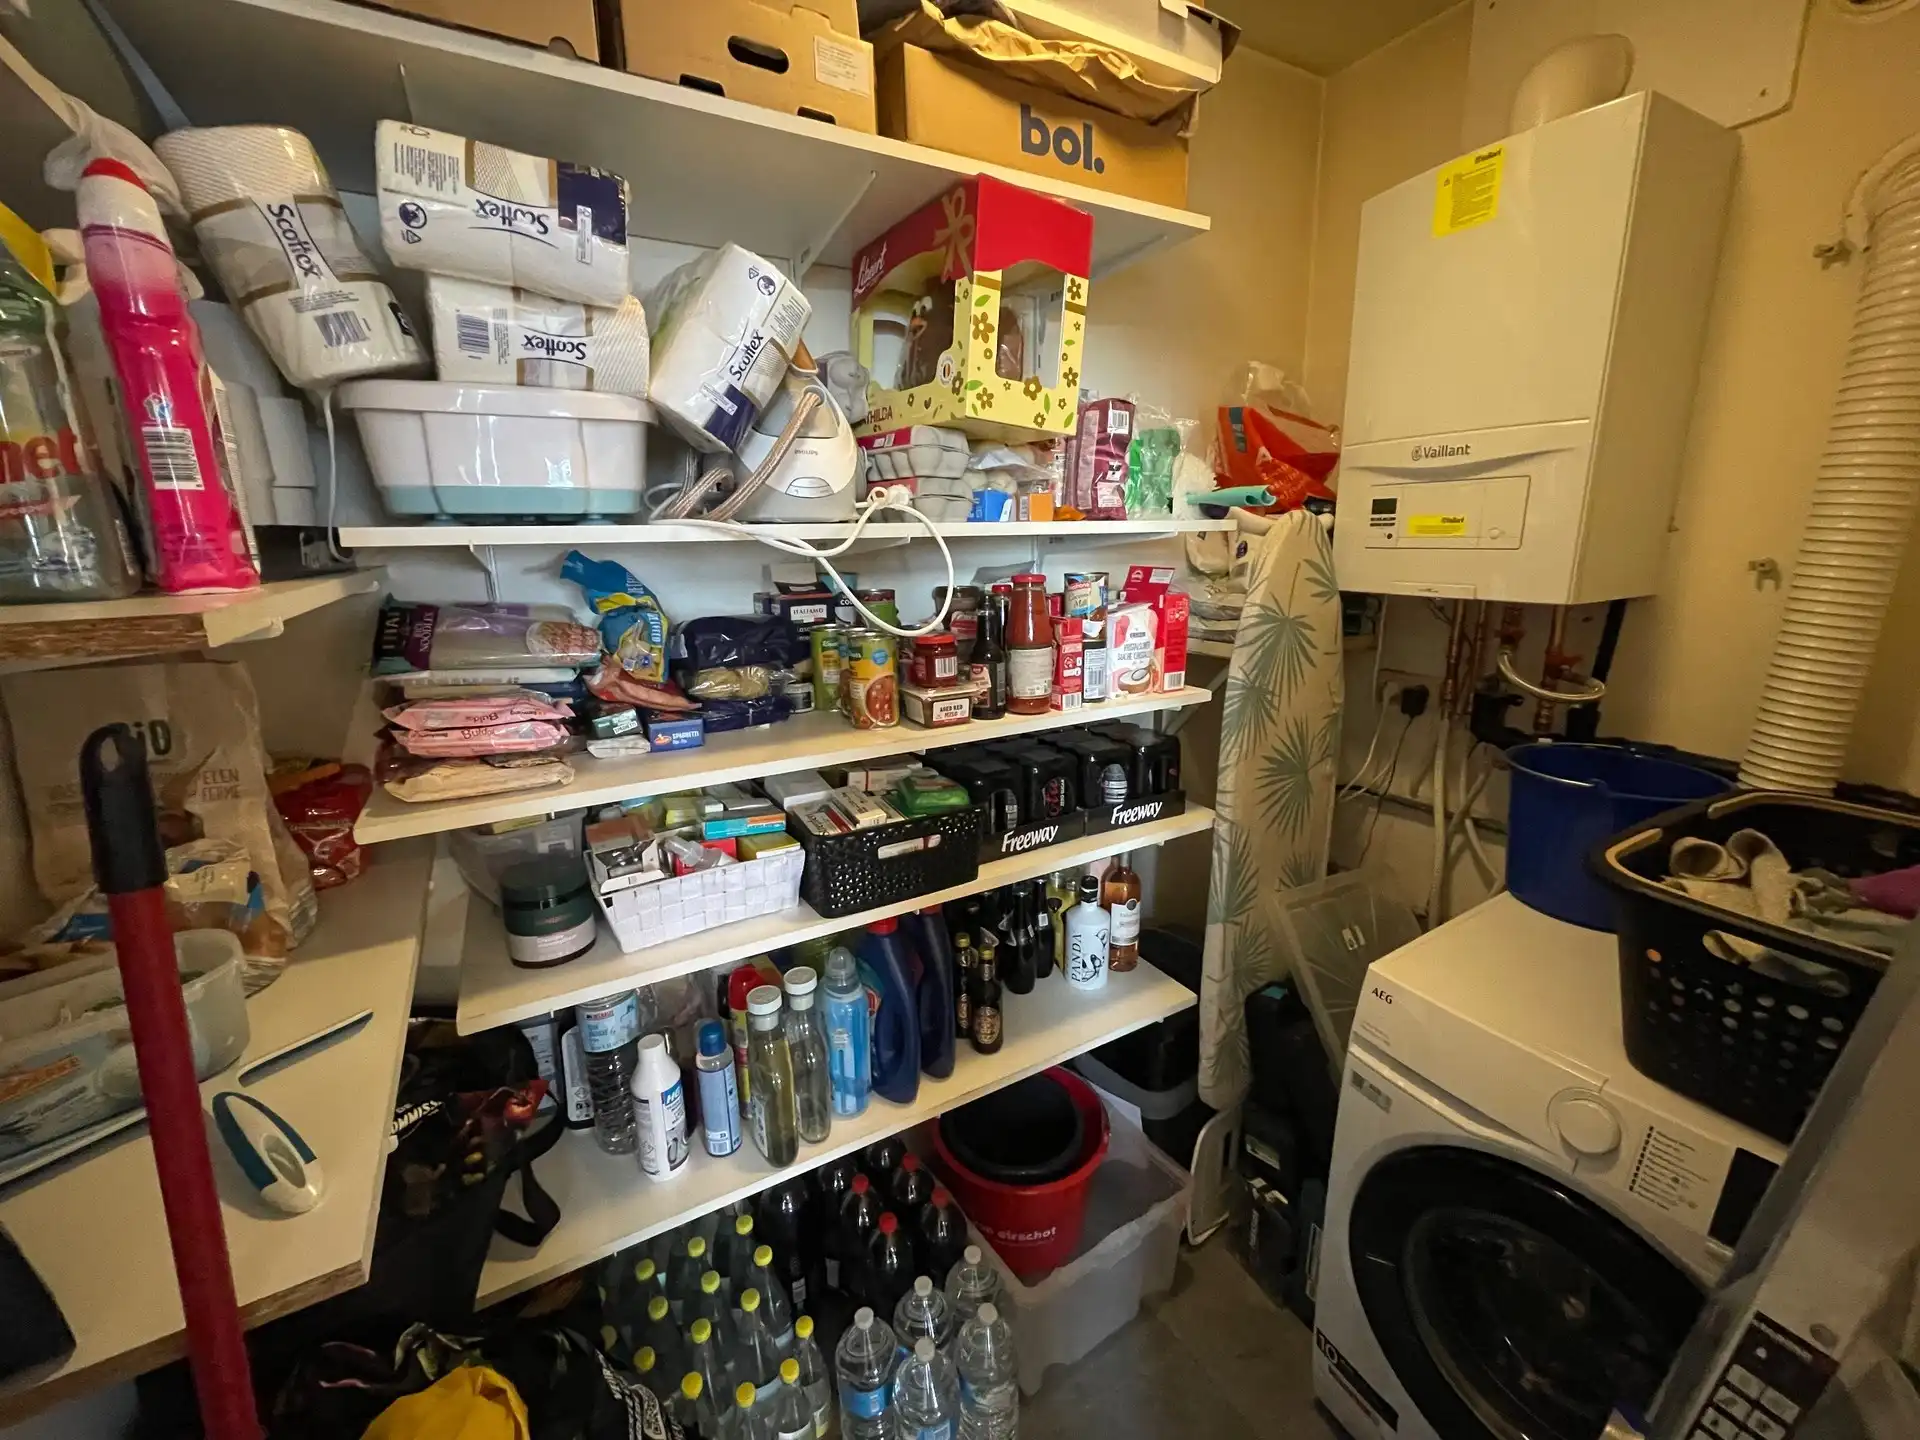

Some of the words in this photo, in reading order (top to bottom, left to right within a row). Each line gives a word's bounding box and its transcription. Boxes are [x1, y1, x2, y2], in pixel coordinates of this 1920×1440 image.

[1020, 103, 1105, 174] bol.
[475, 198, 550, 235] Scottex
[267, 203, 322, 280] Scottex
[523, 334, 588, 360] Scottex
[729, 329, 765, 382] Scottex
[1422, 444, 1471, 460] Vaillant
[792, 607, 824, 616] ITALIAMO
[672, 730, 700, 740] SPAGHETTI
[1111, 801, 1163, 825] Freeway
[1001, 825, 1059, 852] Freeway
[1071, 933, 1082, 982] PANDA
[1371, 987, 1393, 1005] AEG
[1318, 1333, 1338, 1365] 10
